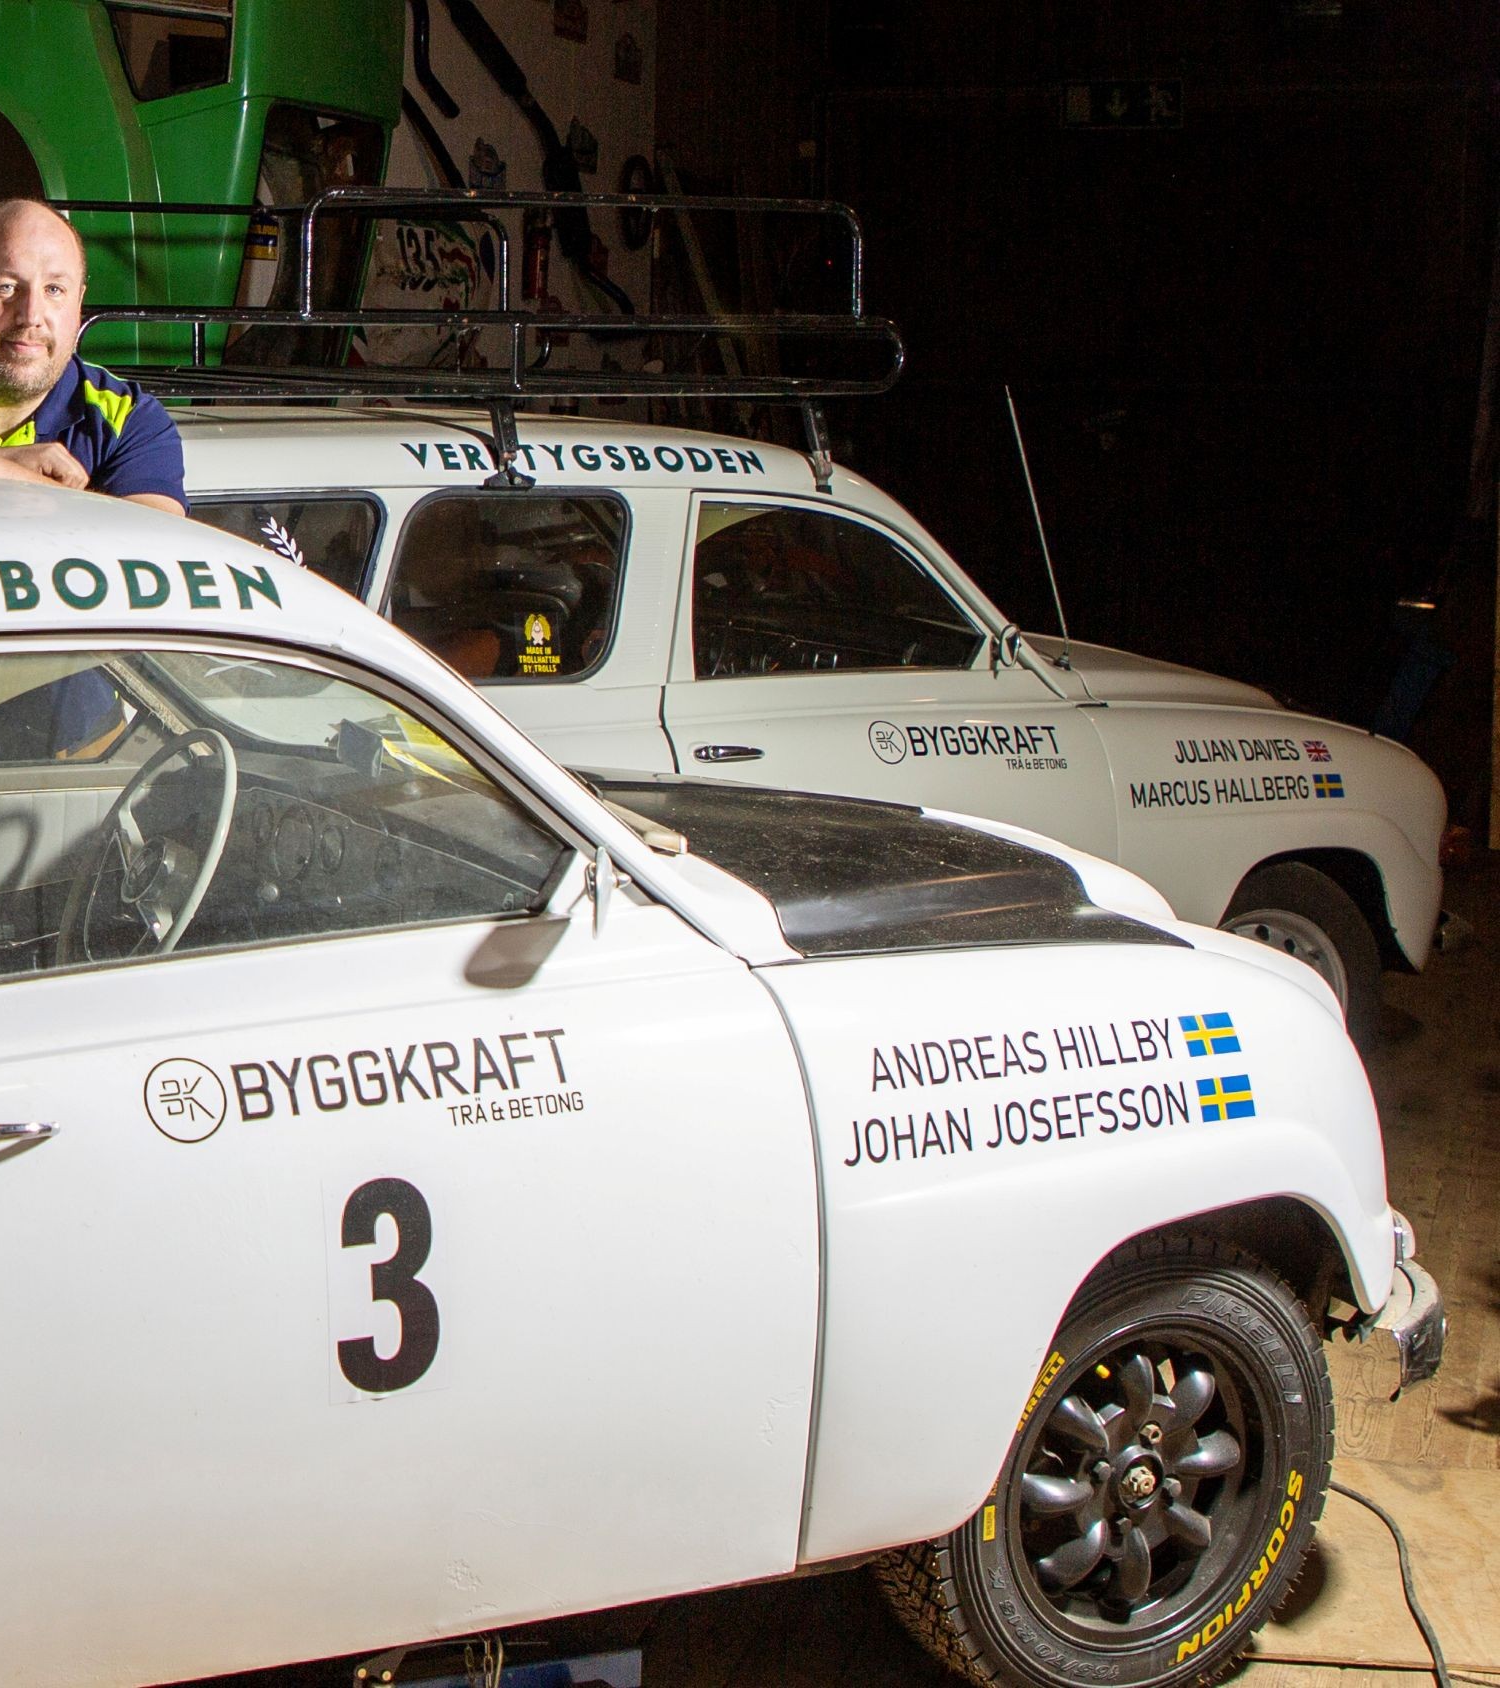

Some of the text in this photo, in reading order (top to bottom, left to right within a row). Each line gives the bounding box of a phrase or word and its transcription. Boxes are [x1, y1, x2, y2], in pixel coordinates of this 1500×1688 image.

[400, 442, 766, 475] VERTYGSBODEN
[526, 647, 543, 655] MADE
[523, 664, 557, 673] BY TROLLS
[905, 726, 1060, 756] BYGGKRAFT
[1175, 739, 1300, 763] JULIAN DAVIES
[1006, 756, 1024, 770] TRÄ
[1033, 758, 1068, 770] BETONG
[1130, 775, 1310, 808] MARCUS HALLBERG
[871, 1017, 1175, 1093] ANDREAS HILLBY
[229, 1028, 568, 1122] BYGGKRAFT
[447, 1091, 584, 1127] TRÄ & BETONG
[843, 1081, 1190, 1167] JOHAN JOSEFSSON
[337, 1177, 440, 1393] 3
[1176, 1287, 1303, 1404] PIRELLI
[1177, 1469, 1304, 1663] SCORPION
